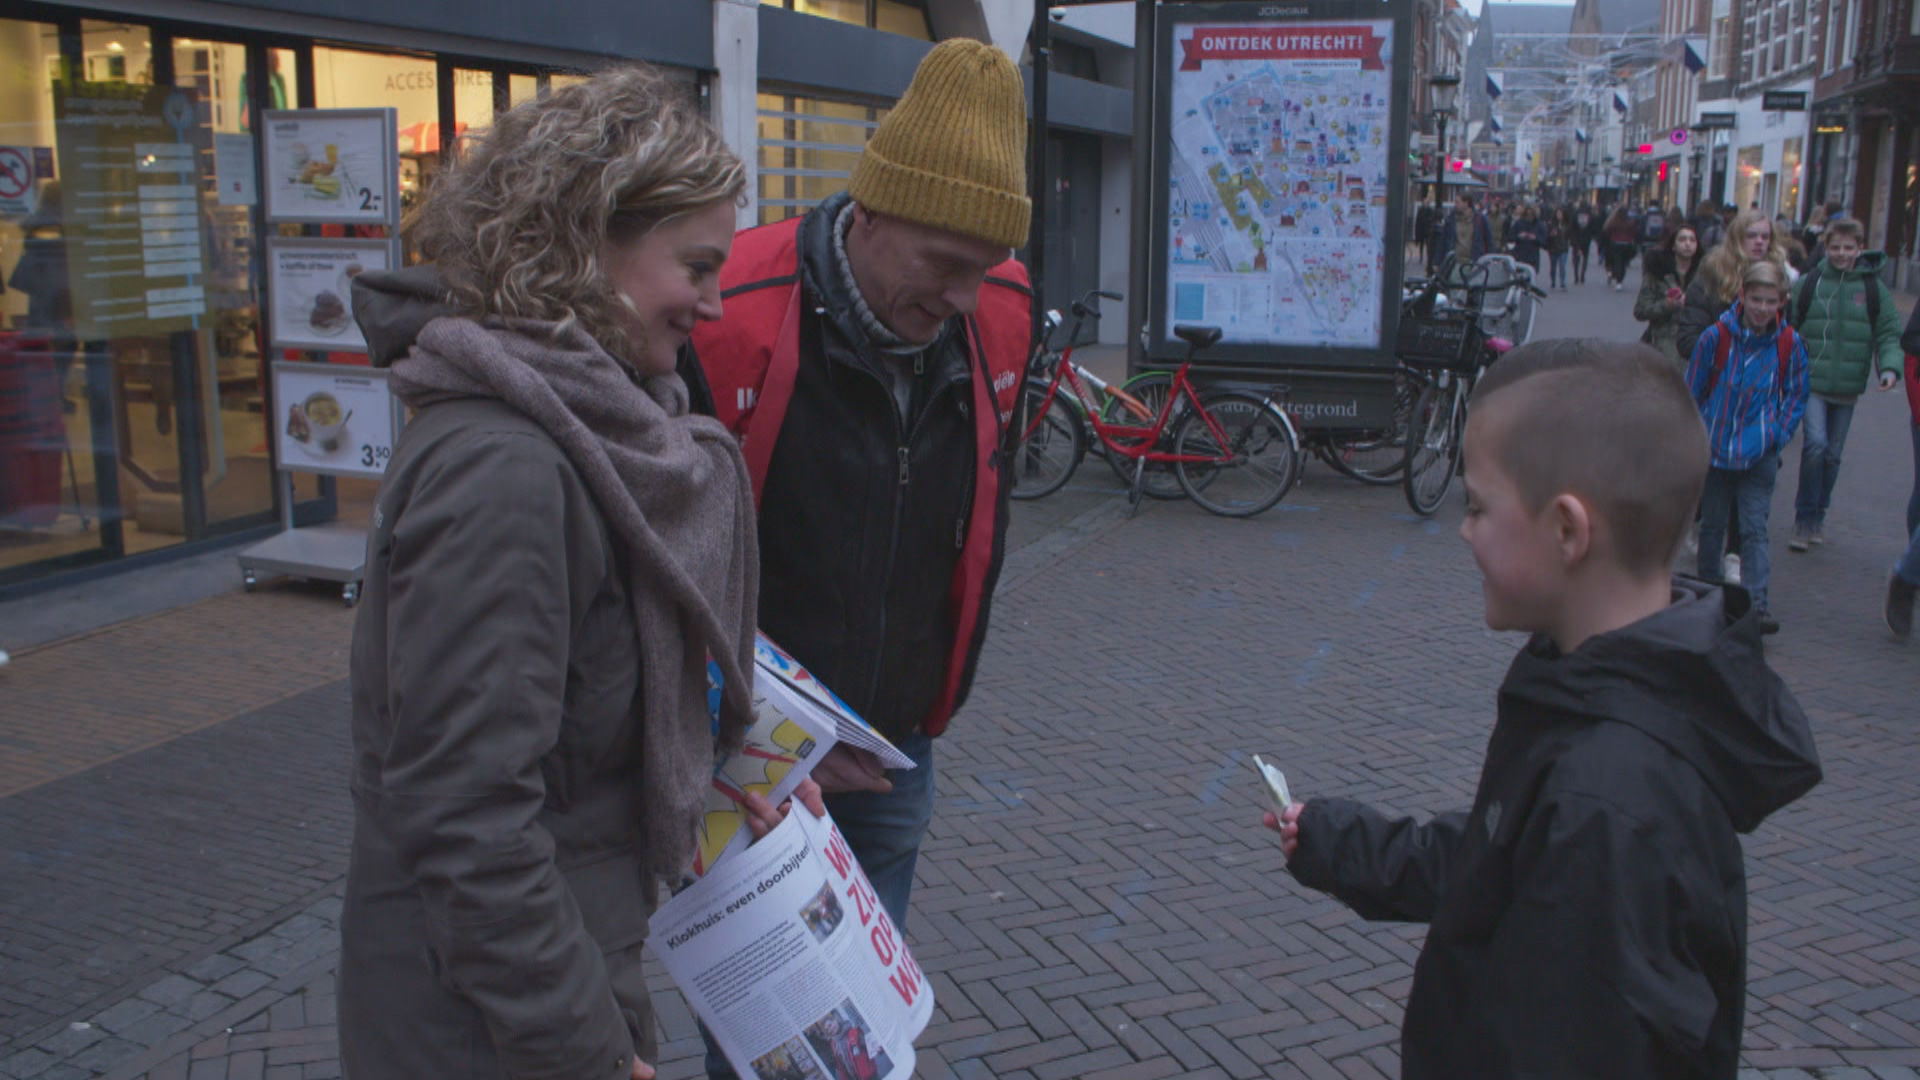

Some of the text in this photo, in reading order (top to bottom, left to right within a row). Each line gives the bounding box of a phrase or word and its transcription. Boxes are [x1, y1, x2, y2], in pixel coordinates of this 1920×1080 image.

[1258, 7, 1309, 16] JCDecaux
[1202, 35, 1363, 51] ONTDEK UTRECHT!
[666, 909, 725, 950] Klokhuis:
[725, 891, 757, 915] even
